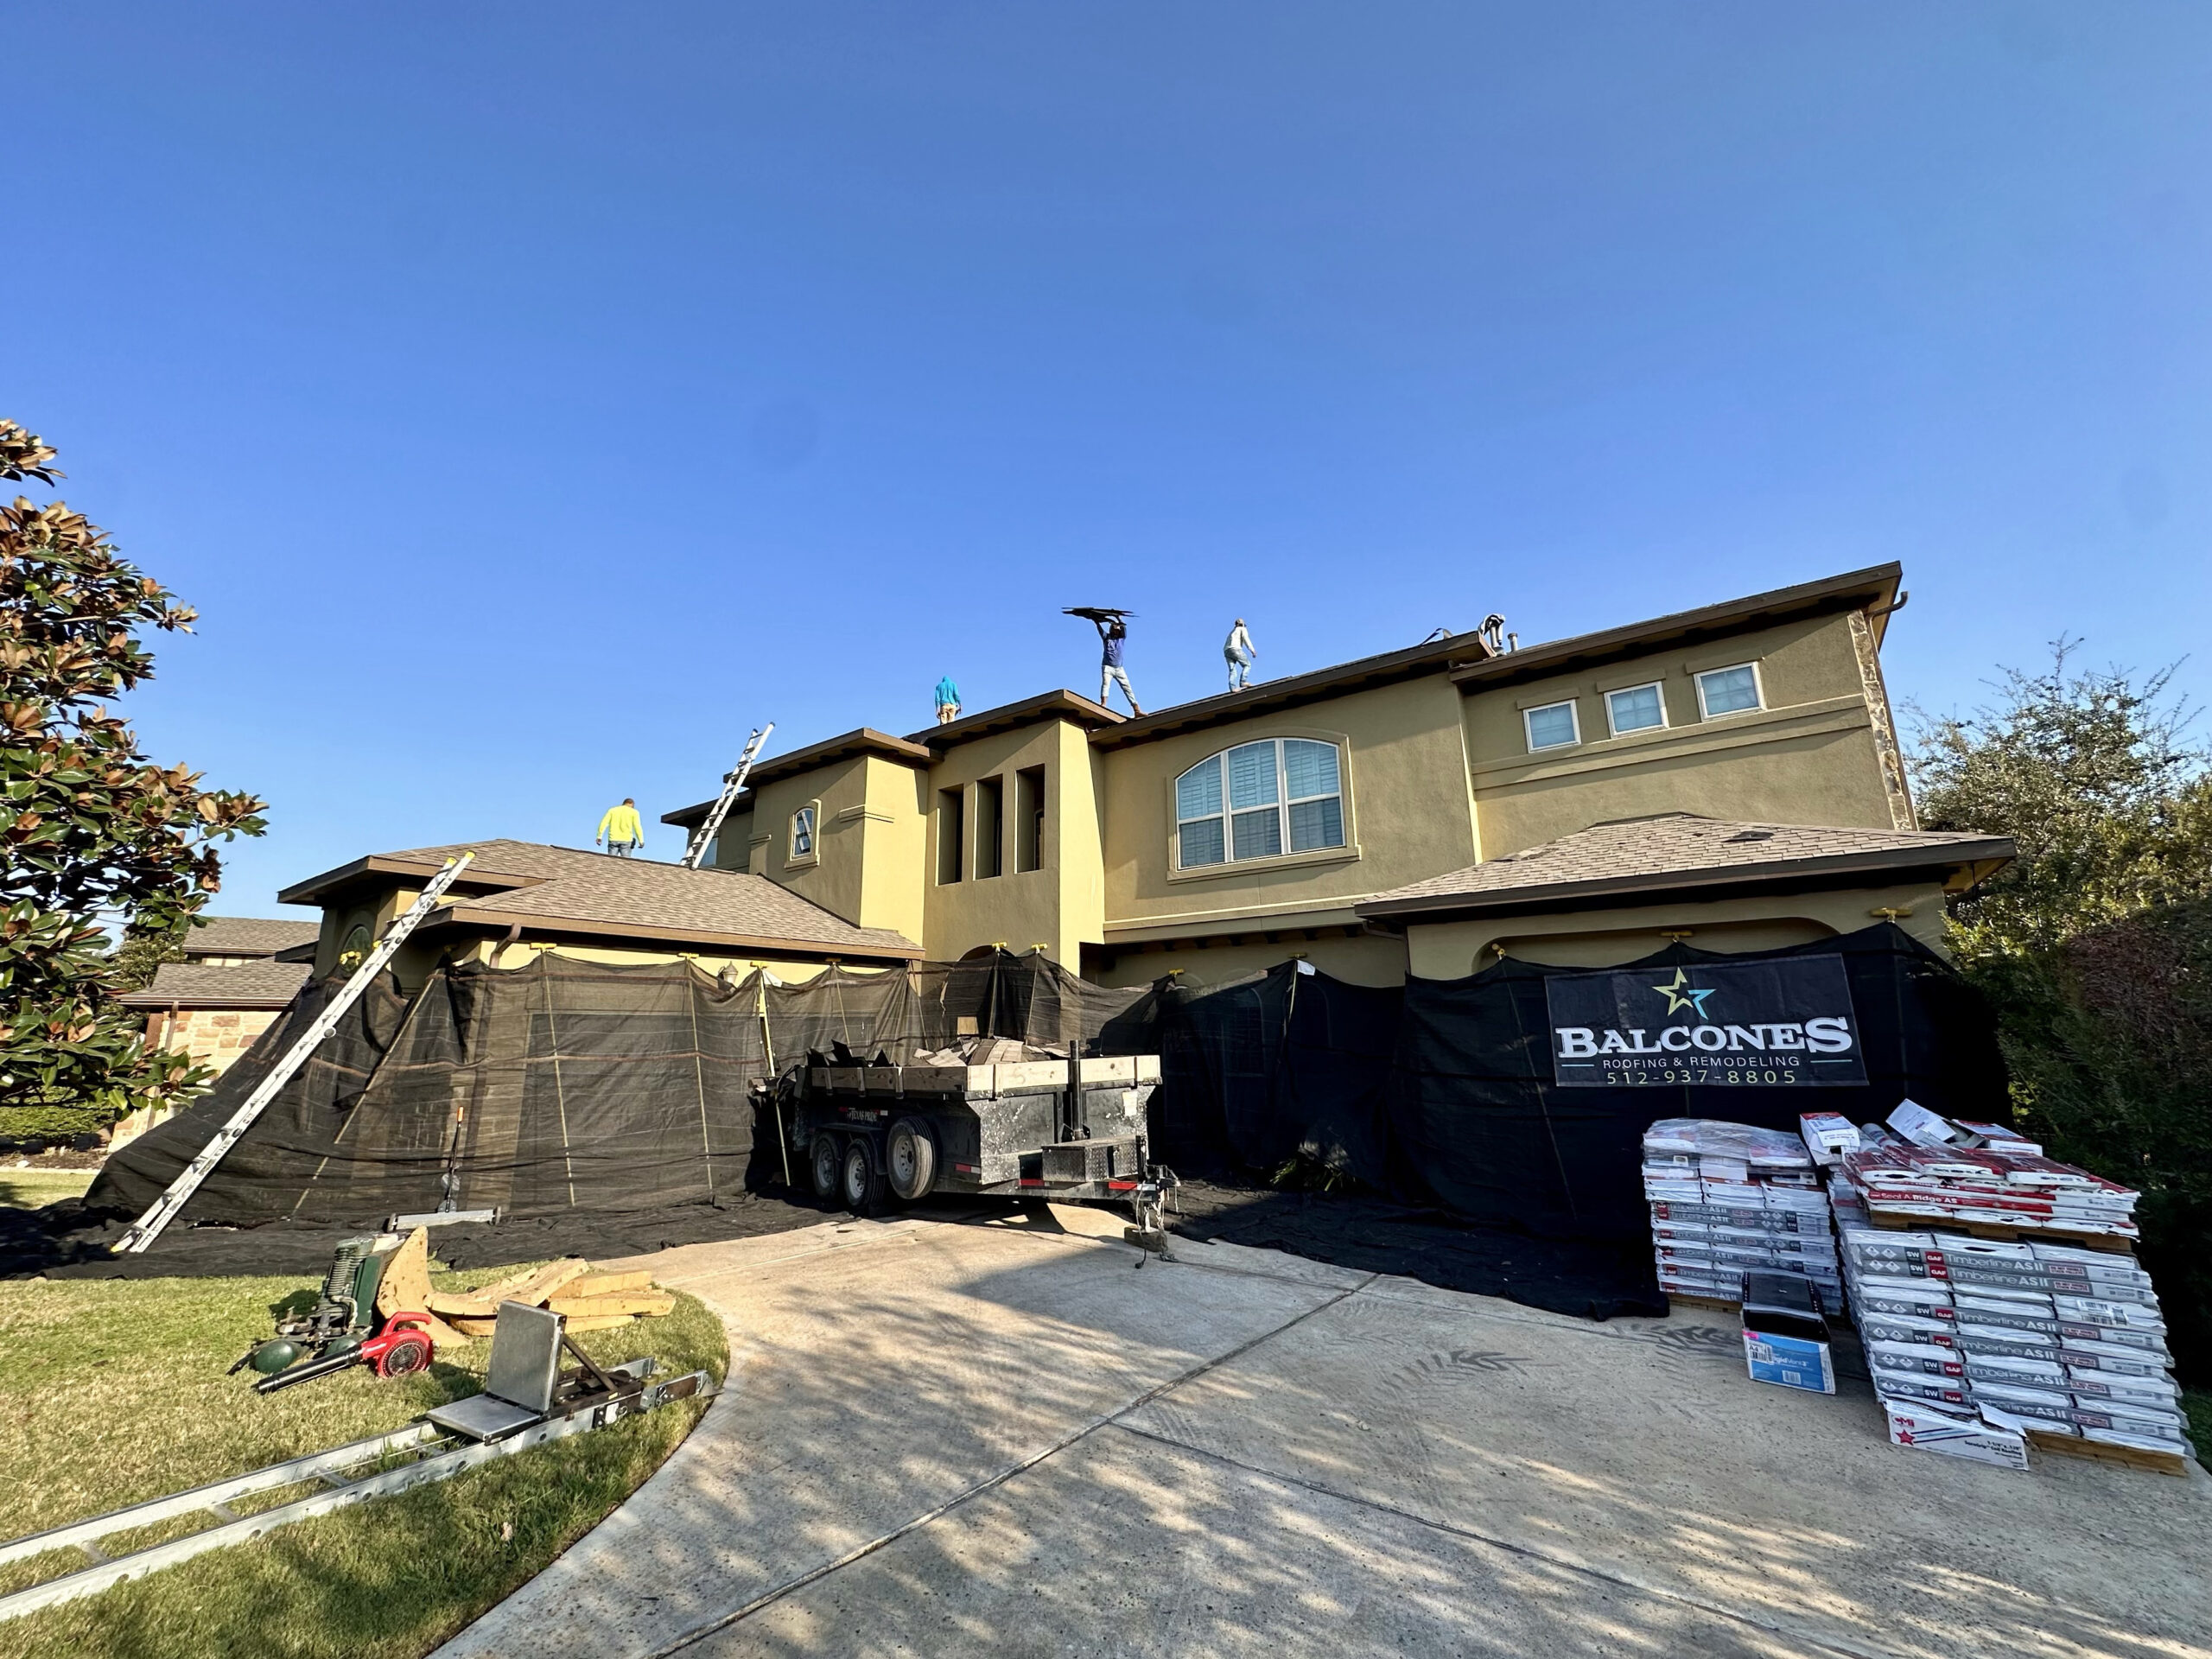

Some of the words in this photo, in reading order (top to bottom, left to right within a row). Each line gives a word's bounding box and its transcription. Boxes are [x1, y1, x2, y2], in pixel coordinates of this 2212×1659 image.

[1556, 1016, 1853, 1058] BALCONES
[1603, 1058, 1668, 1069] ROOFING
[1673, 1057, 1683, 1067] &
[1690, 1056, 1800, 1067] REMODELING
[1607, 1070, 1796, 1084] 512-937-8805
[1912, 1194, 1942, 1203] Ridge
[1947, 1254, 2014, 1268] Timberline
[1950, 1268, 2017, 1285] Timberline
[1956, 1311, 2025, 1327] Timberline
[1955, 1339, 2023, 1355] Timberline
